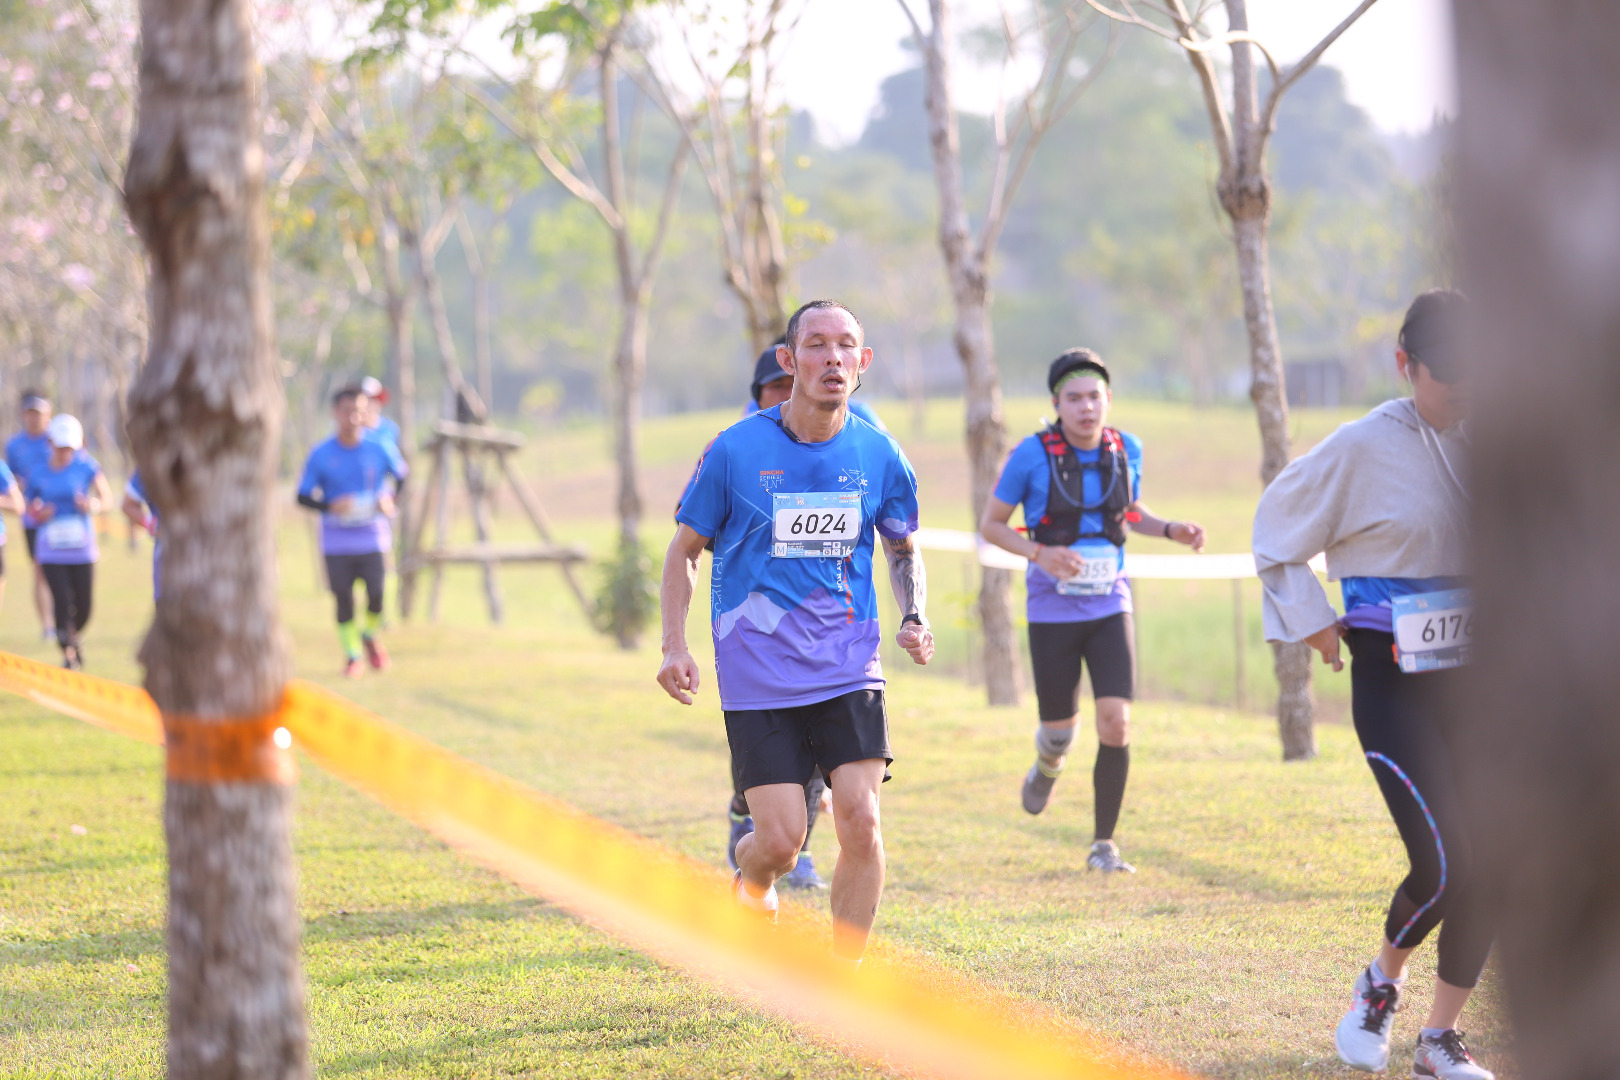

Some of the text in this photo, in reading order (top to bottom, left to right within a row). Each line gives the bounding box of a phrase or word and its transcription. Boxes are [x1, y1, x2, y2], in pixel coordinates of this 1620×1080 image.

[791, 514, 846, 534] 6024
[777, 546, 784, 554] M
[1080, 561, 1109, 579] 355
[846, 607, 854, 624] RAI
